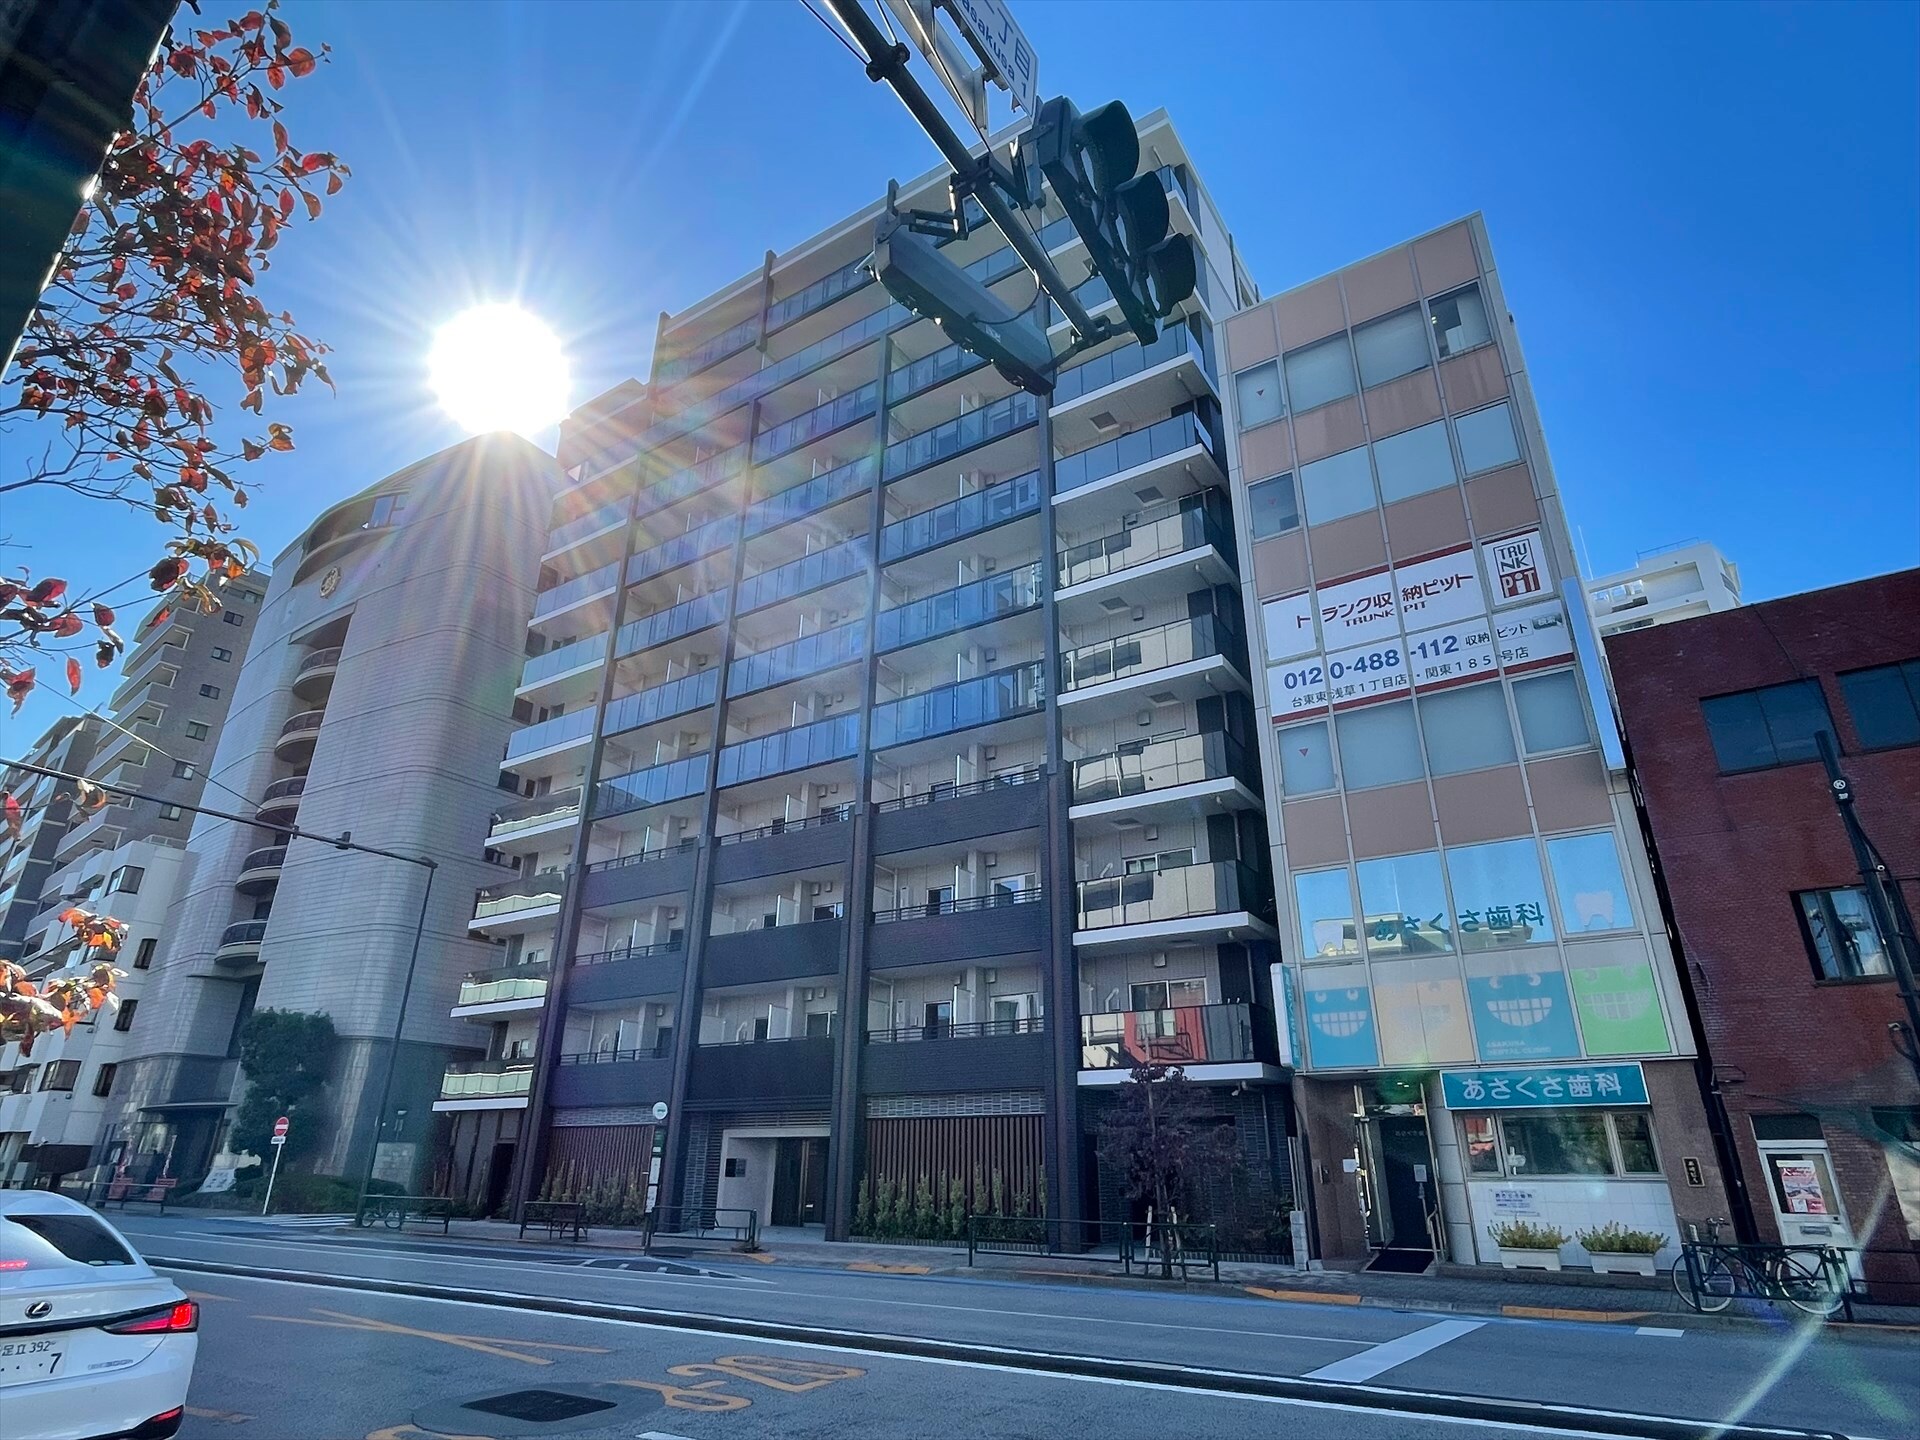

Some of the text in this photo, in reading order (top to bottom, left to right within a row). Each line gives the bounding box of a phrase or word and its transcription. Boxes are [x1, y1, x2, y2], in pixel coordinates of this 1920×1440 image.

[1497, 542, 1528, 560] TRU
[1500, 554, 1530, 573] NK
[1296, 573, 1474, 629] トランク収納ピット
[1343, 600, 1428, 627] TRUNK PIT
[1283, 635, 1460, 690] 0120-488-112
[1462, 1072, 1623, 1101] あさくさ歯科
[29, 1340, 51, 1354] 392
